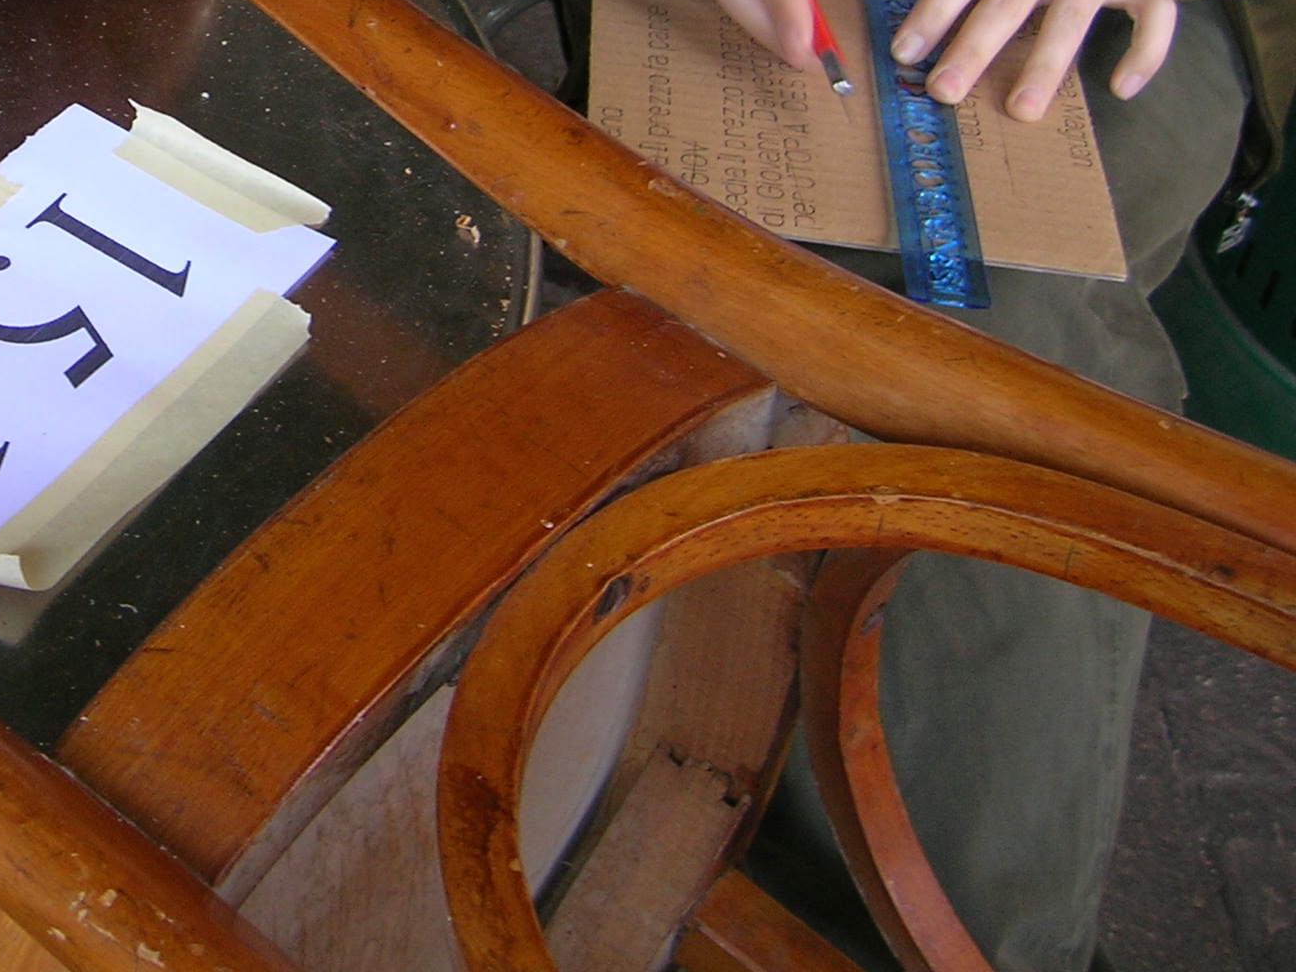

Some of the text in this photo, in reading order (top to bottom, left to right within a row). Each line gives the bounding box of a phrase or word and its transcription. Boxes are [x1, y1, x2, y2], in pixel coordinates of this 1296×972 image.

[644, 5, 675, 51] parte
[642, 55, 669, 72] fa
[716, 65, 742, 83] fa
[644, 74, 674, 138] prezzo
[721, 85, 751, 150] prezzo
[754, 126, 785, 200] Giovanni
[783, 123, 815, 189] UTOPIA
[756, 205, 786, 228] di
[792, 191, 822, 230] per
